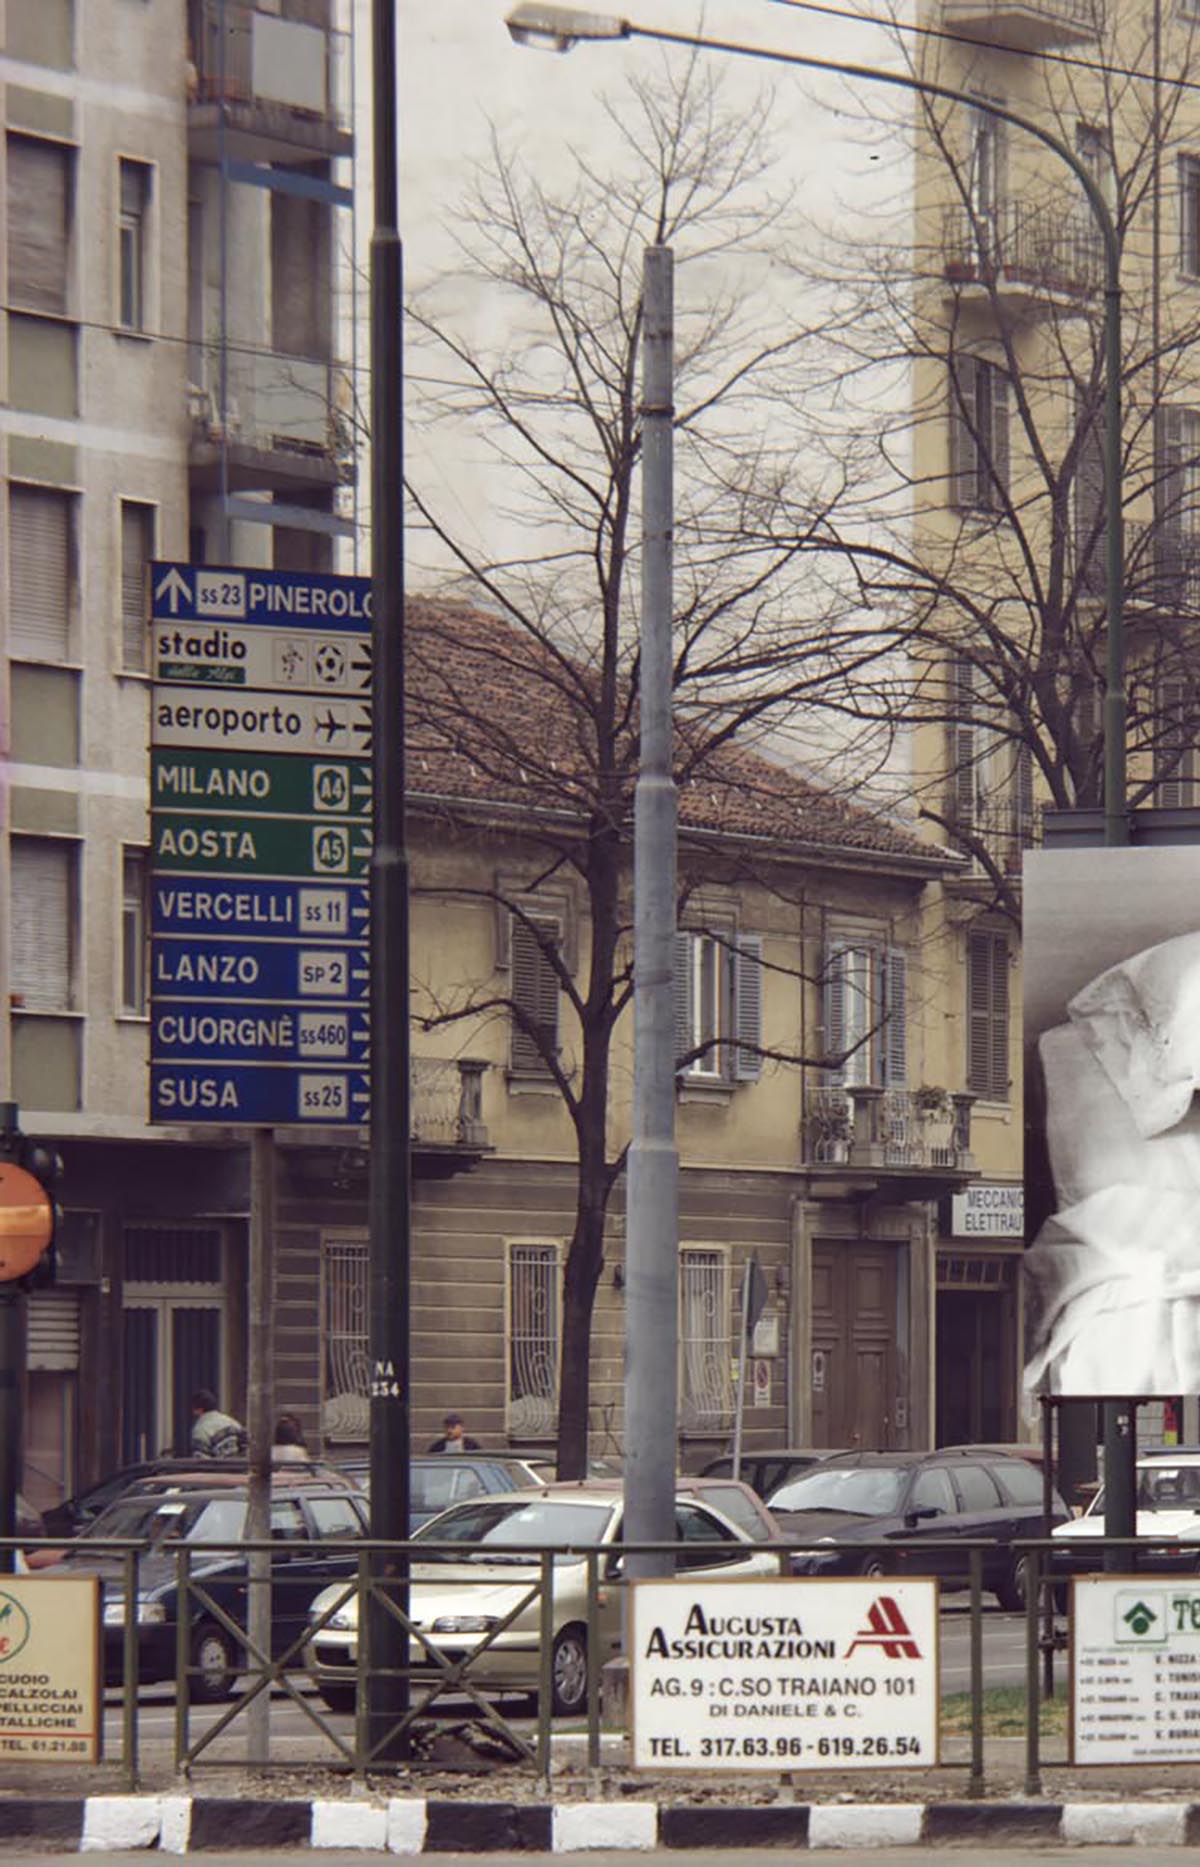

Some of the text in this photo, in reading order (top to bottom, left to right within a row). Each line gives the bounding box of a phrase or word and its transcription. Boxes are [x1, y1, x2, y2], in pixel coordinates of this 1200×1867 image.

[158, 630, 247, 660] stadio
[158, 704, 301, 736] aeroporto
[157, 764, 343, 799] MILANO A4
[159, 828, 342, 862] AOSTA A5
[158, 891, 293, 923] VERCELLI
[157, 954, 259, 983] LANZO
[329, 962, 342, 984] 2
[158, 1079, 239, 1108] SUSA
[650, 1677, 687, 1697] AG.
[719, 1677, 772, 1697] C.SO
[776, 1677, 877, 1697] TRAIANO
[884, 1677, 915, 1696] 101
[0, 1703, 83, 1714] ELLICCIAI
[709, 1704, 862, 1718] DI DANIELE & C.
[649, 1738, 691, 1757] TEL.
